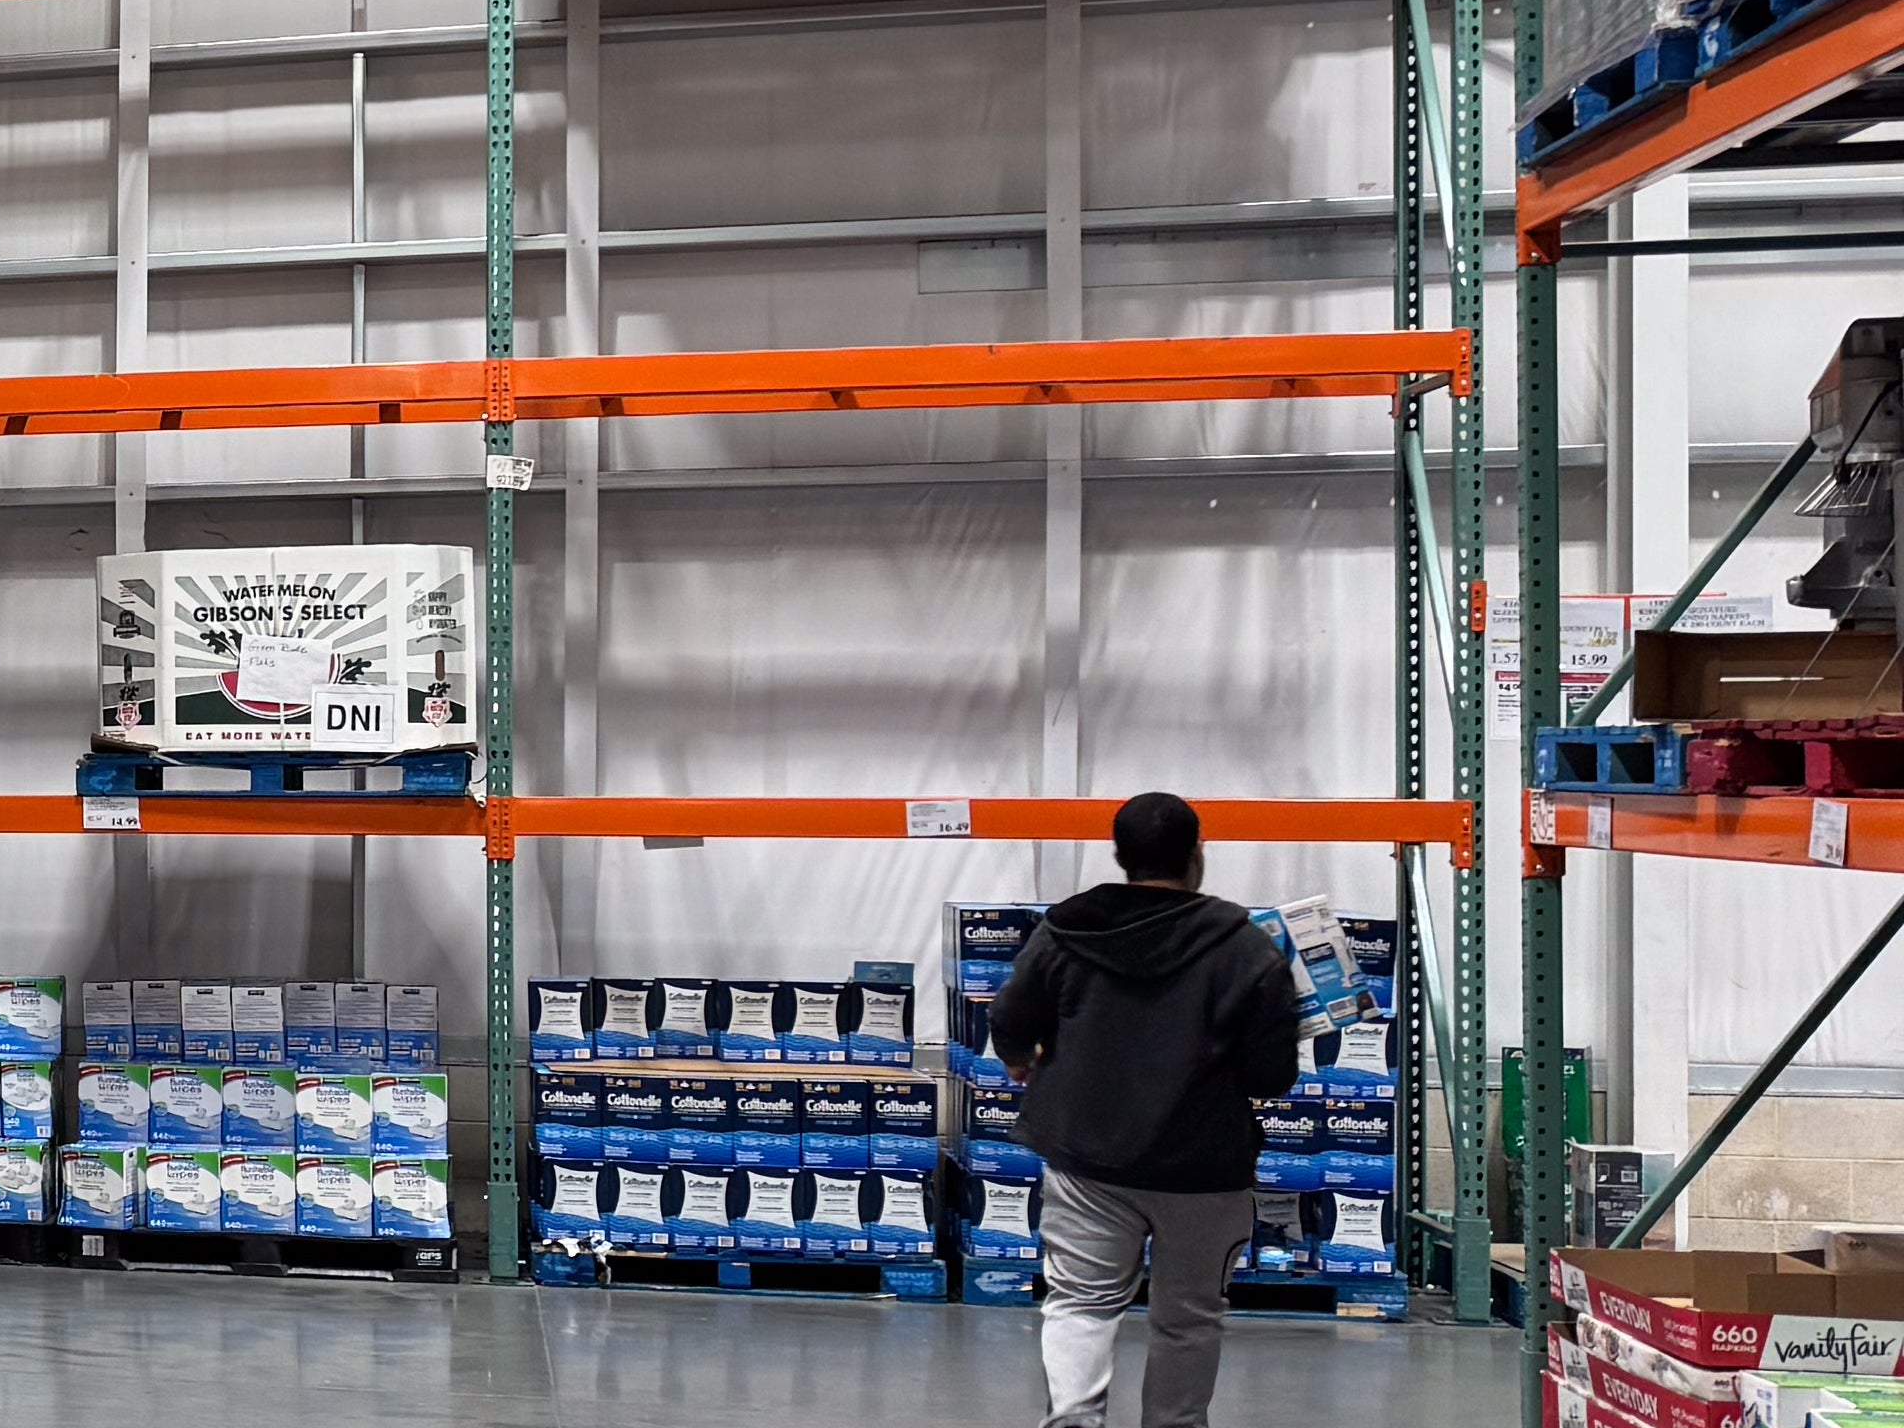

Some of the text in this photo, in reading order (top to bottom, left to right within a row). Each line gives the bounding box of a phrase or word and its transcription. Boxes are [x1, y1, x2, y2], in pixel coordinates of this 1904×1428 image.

[223, 584, 336, 602] WATERMELON
[193, 604, 367, 623] GIBSON'S SELECT
[1571, 654, 1607, 666] 15.99
[327, 704, 381, 731] DNI
[186, 732, 262, 741] EAT MORE
[939, 822, 969, 832] 16.49
[964, 926, 1022, 940] Cottonelle
[544, 995, 577, 1004] Cottonelle
[609, 994, 643, 1004] Cottonelle
[669, 993, 702, 1002] Cottonelle
[735, 996, 769, 1005] Cottonelle
[800, 996, 834, 1006] Cottonelle
[867, 997, 900, 1007] Cottonelle
[541, 1091, 596, 1105] Cottonelle
[607, 1093, 662, 1108] Cottonelle
[671, 1096, 727, 1110] Cottonelle
[737, 1098, 794, 1111] Cottonelle
[805, 1100, 863, 1113] Cottonelle
[875, 1100, 932, 1114] Cottonelle
[1327, 1116, 1389, 1131] Cottonelle
[559, 1175, 593, 1185] Cottonelle
[623, 1177, 658, 1187] Cottonelle
[687, 1179, 722, 1189] Cottonelle
[753, 1181, 788, 1191] Cottonelle
[820, 1183, 855, 1192] Cottonelle
[888, 1185, 922, 1194] Cottonelle
[988, 1189, 1026, 1200] Cottonelle
[1340, 1203, 1379, 1213] Cottonelle
[1599, 1291, 1653, 1335] EVERYDAY
[1712, 1325, 1758, 1343] 660
[1712, 1344, 1758, 1353] NAPKINS
[1602, 1373, 1659, 1420] EVERYDAY
